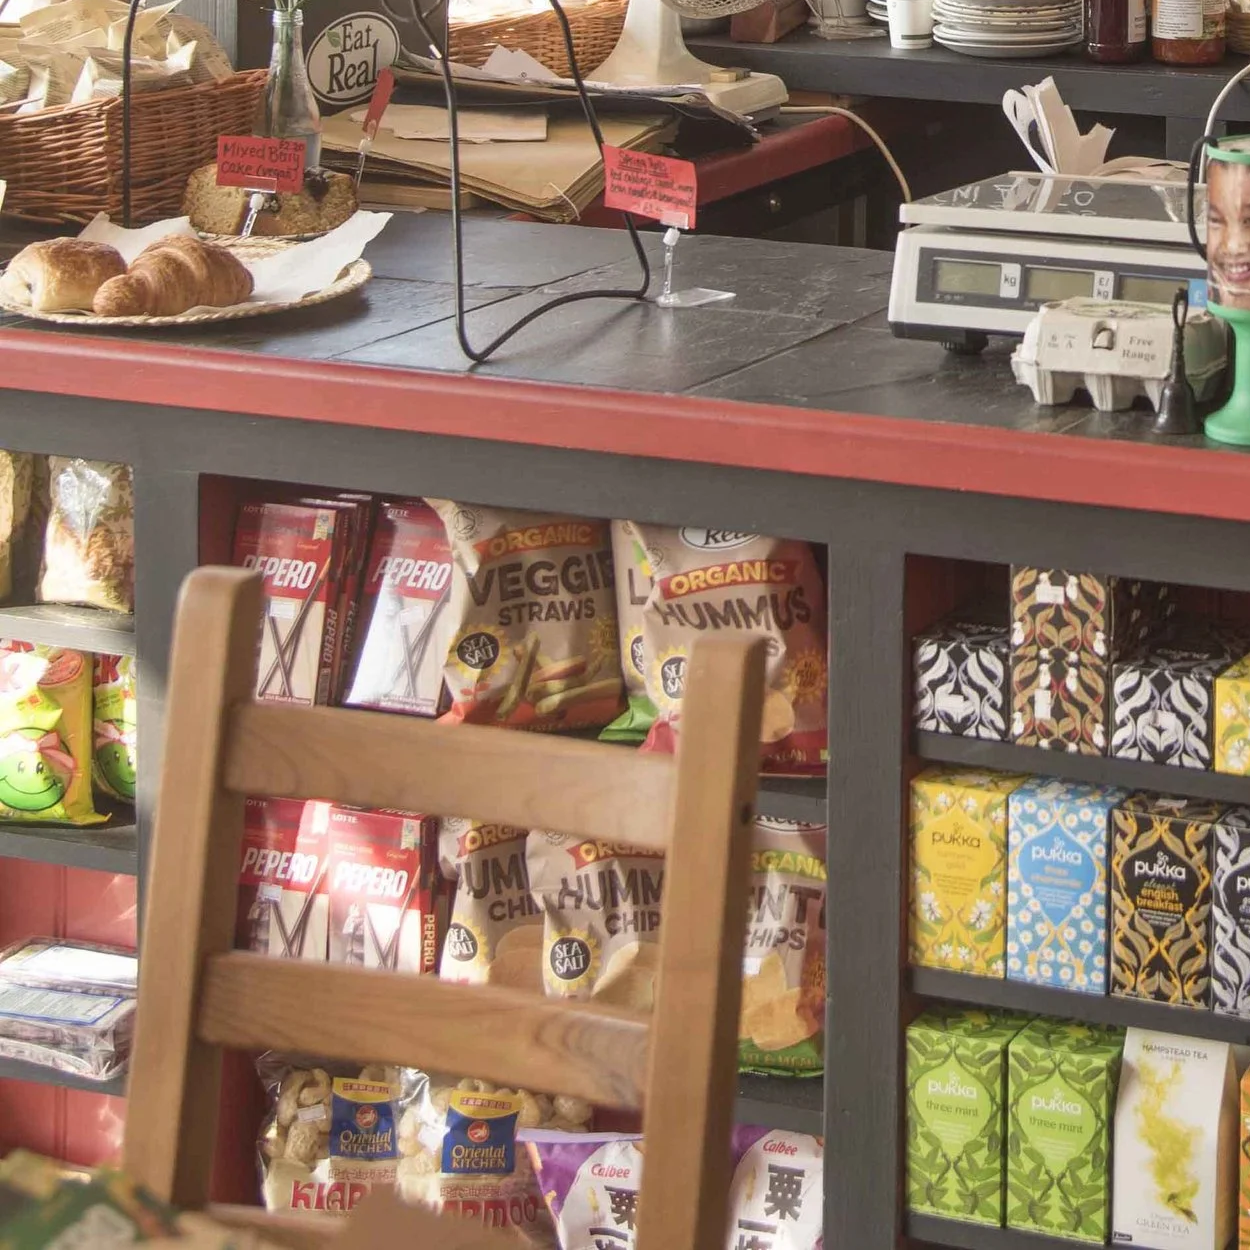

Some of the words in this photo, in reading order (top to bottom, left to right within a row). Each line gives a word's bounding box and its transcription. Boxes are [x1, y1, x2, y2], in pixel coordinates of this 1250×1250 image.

[341, 22, 372, 53] Eat
[327, 39, 380, 94] Real
[223, 142, 265, 159] Mixed
[1003, 273, 1017, 287] kg
[1128, 335, 1155, 346] Free
[1122, 349, 1157, 362] Range
[489, 525, 593, 557] ORGANIC
[373, 556, 452, 591] PEPERO
[670, 560, 786, 595] ORGANIC
[498, 598, 596, 626] STRAWS
[652, 586, 812, 631] HUMMUS
[322, 608, 338, 664] PEPERO
[463, 635, 491, 650] SEA
[465, 646, 495, 665] SALT
[931, 828, 981, 848] pukka
[1032, 842, 1082, 864] pukka
[241, 847, 318, 884] PEPERO
[1134, 857, 1186, 880] pukka
[334, 861, 408, 898] PEPERO
[1136, 895, 1183, 912] breakfast
[1141, 888, 1179, 901] english
[604, 910, 661, 935] CHIP
[423, 914, 435, 966] PEPERO
[554, 941, 583, 958] SEA
[555, 955, 586, 975] SALT
[1142, 1044, 1191, 1057] HAMPSTEAD
[1193, 1051, 1208, 1060] TEA
[928, 1075, 977, 1099] pukka
[926, 1100, 952, 1113] three
[955, 1107, 978, 1117] mint
[1031, 1092, 1082, 1115] pukka
[1029, 1116, 1056, 1130] three
[1059, 1123, 1083, 1134] mint
[340, 1129, 392, 1145] Oriental
[340, 1143, 392, 1153] KITCHEN
[452, 1144, 506, 1160] Oriental
[763, 1139, 798, 1156] Calbee
[452, 1156, 506, 1168] KITCHEN
[591, 1162, 630, 1178] Calbee
